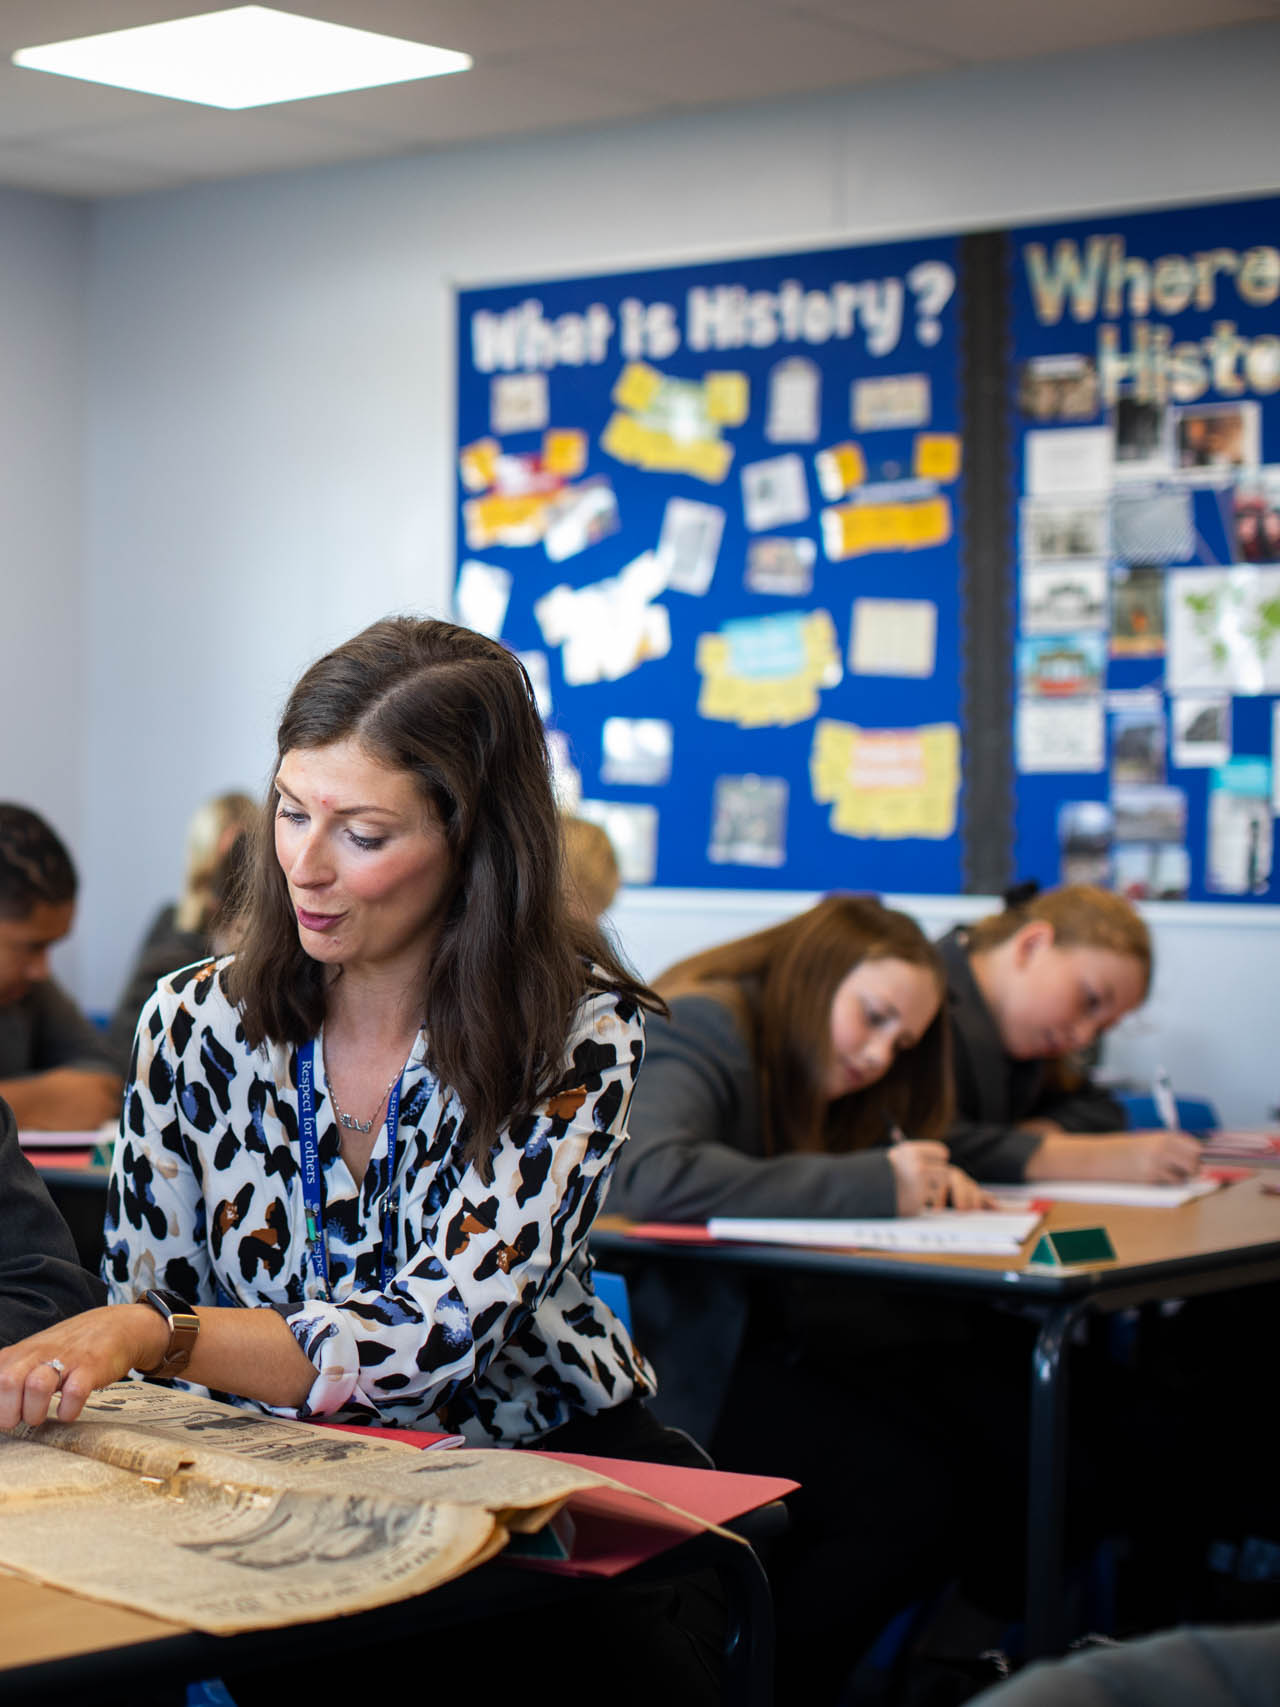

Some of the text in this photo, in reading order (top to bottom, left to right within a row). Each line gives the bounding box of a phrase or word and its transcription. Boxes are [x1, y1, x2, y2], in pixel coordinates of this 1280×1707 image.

[1024, 234, 1280, 326] Where
[471, 298, 613, 373] What
[299, 1060, 312, 1112] Respect
[303, 1117, 316, 1137] for
[305, 1141, 318, 1184] others
